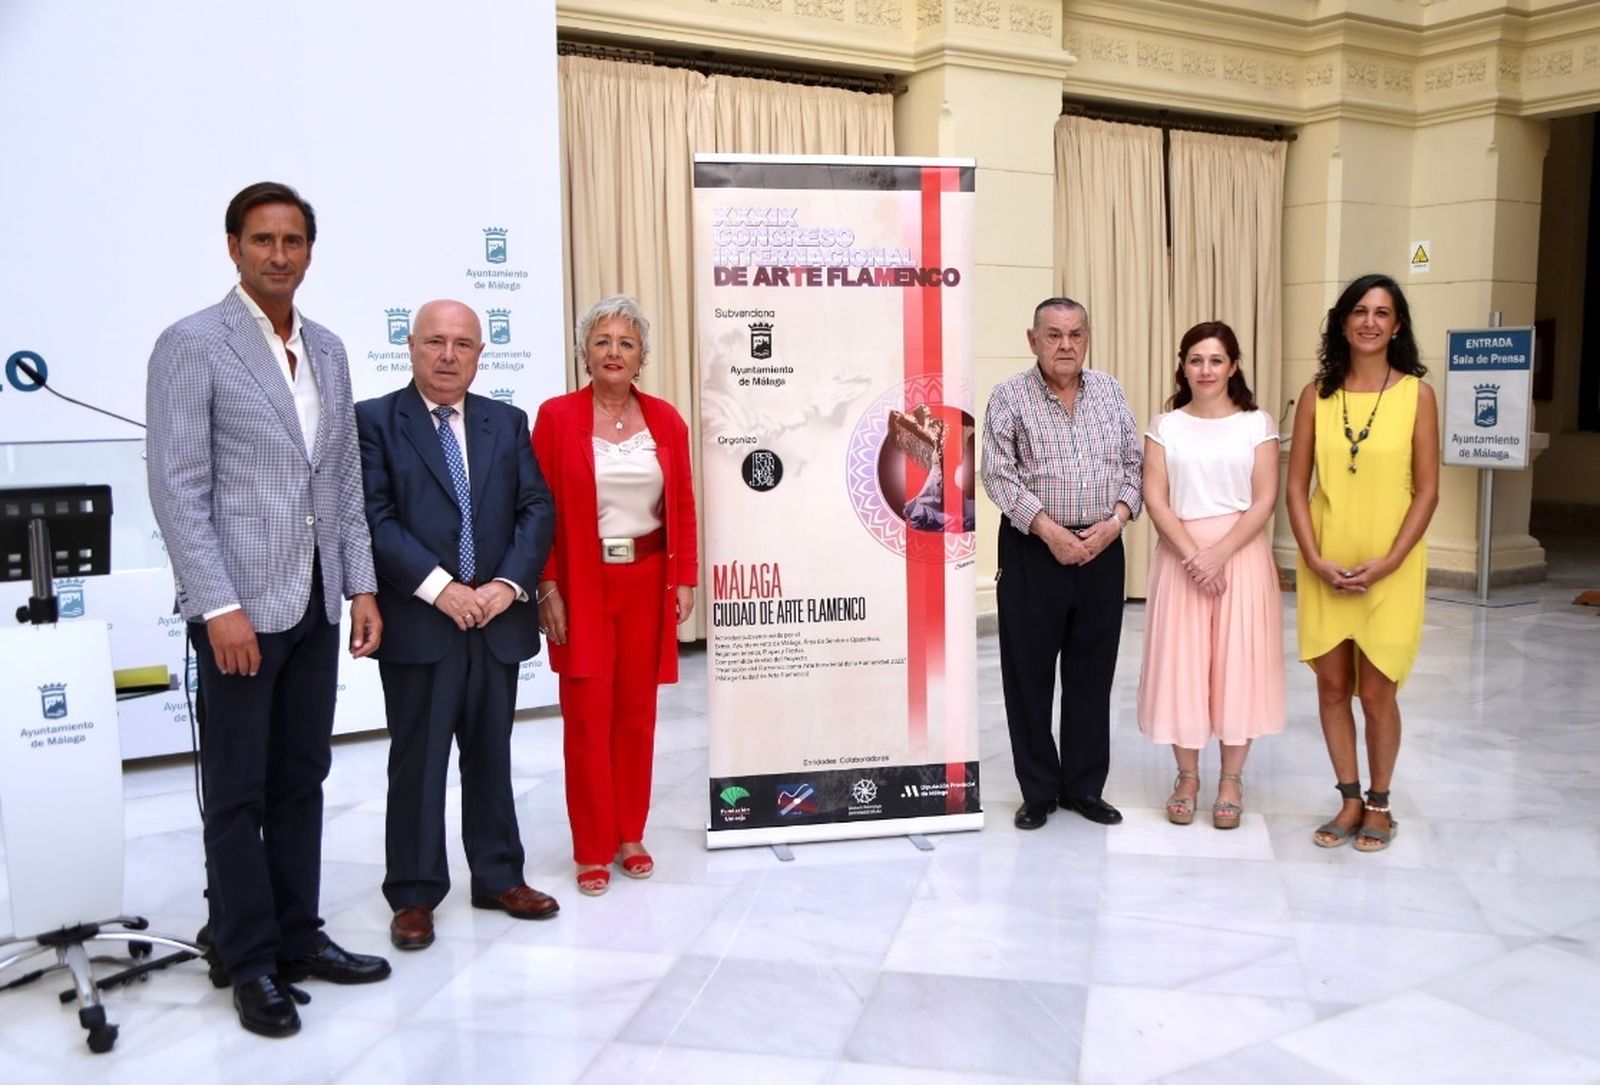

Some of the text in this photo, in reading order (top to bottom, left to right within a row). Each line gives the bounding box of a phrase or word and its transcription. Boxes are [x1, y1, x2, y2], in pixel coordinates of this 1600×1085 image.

[713, 207, 798, 227] XXXIX
[713, 228, 855, 247] CONGRESO
[714, 248, 917, 267] INTERNACIONAL
[465, 268, 528, 279] Ayuntamiento
[714, 266, 961, 287] DE ARTE FLAMENCO
[474, 280, 521, 291] de Málaga
[715, 307, 775, 318] Subvenciona
[1465, 337, 1513, 349] ENTRADA
[368, 350, 410, 361] Ayuntam
[481, 350, 532, 359] untamiento
[1452, 353, 1526, 365] Sala de Prensa
[376, 362, 413, 371] de Mála
[478, 361, 525, 372] de Málaga
[730, 364, 794, 376] Ayuntamiento
[738, 376, 786, 387] de Málaga
[1452, 433, 1520, 446] Ayuntamiento
[1459, 447, 1510, 461] de Málaga
[713, 560, 783, 600] MÁLAGA
[713, 596, 866, 627] CIUDAD DE ARTE FLAMENCO
[20, 721, 94, 738] Ayuntamiento
[31, 734, 86, 748] de Málaga
